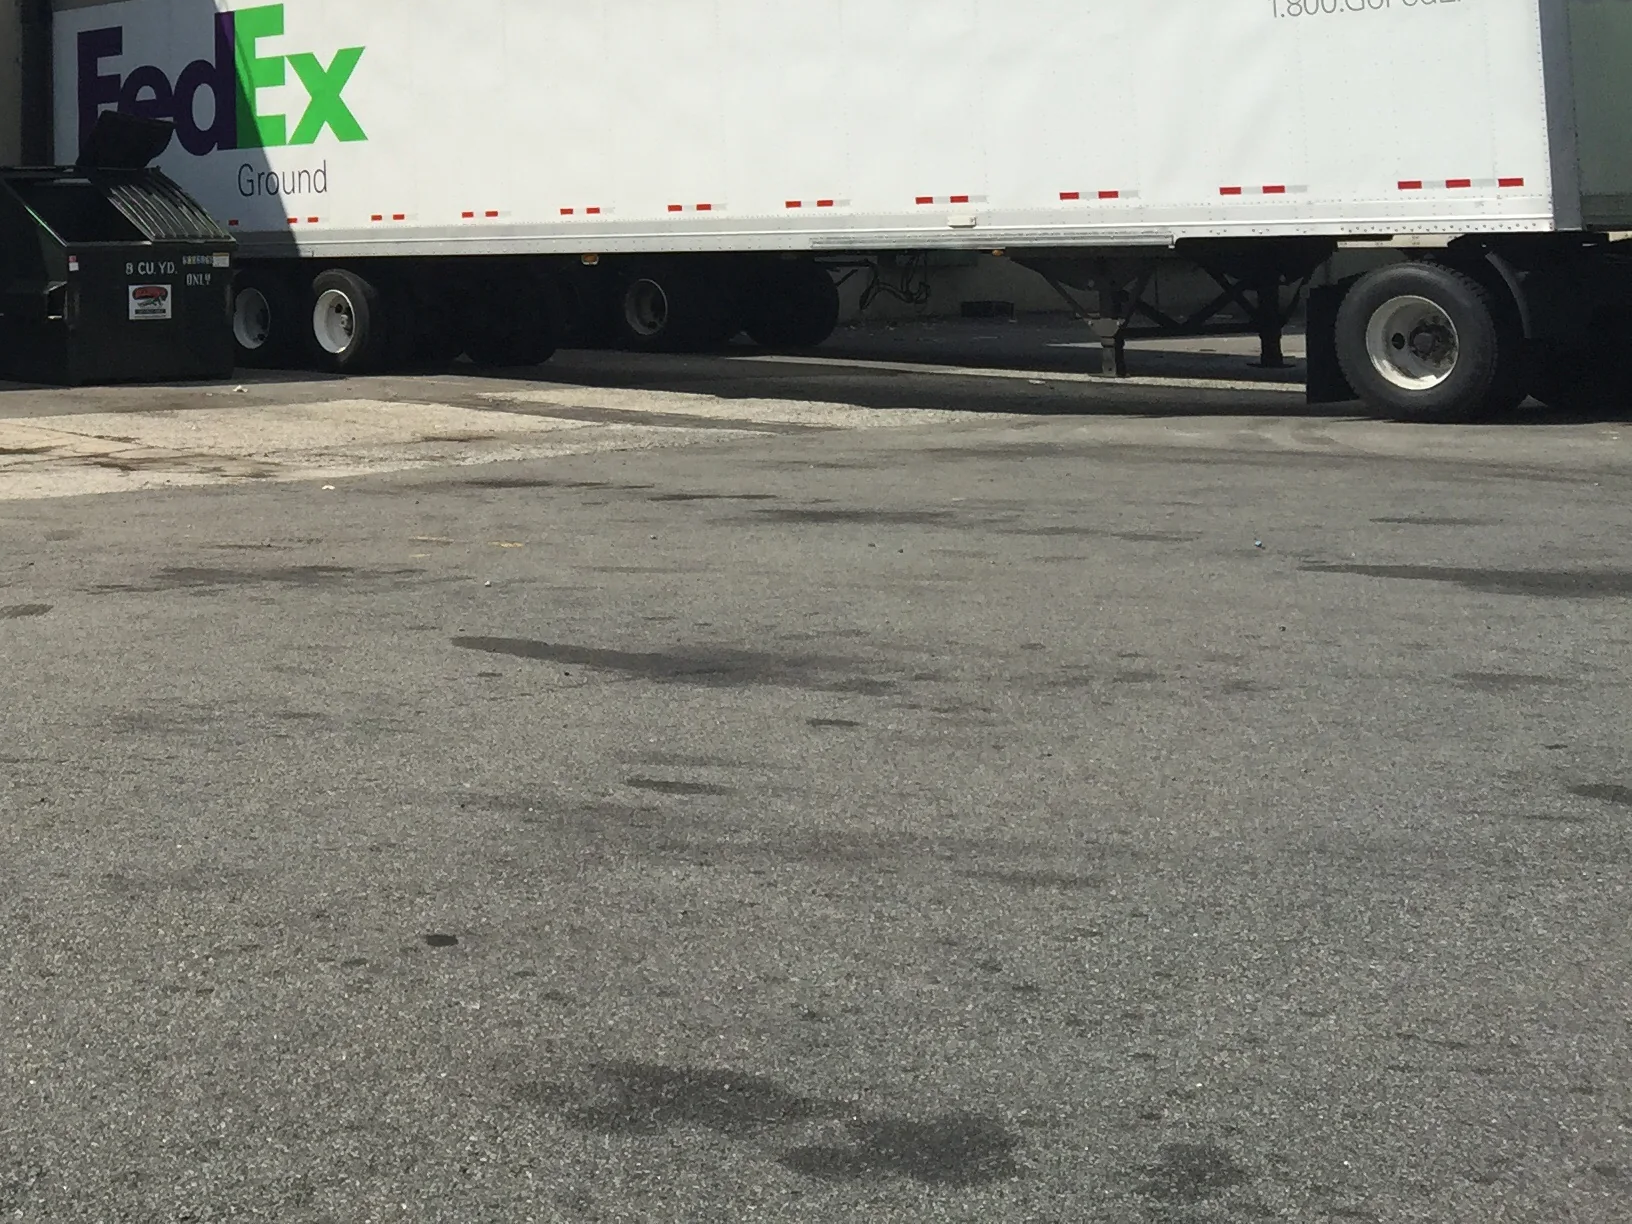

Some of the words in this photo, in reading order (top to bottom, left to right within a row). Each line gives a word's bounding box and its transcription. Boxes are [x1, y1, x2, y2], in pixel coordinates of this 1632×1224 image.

[77, 3, 368, 157] FedEx
[237, 159, 328, 197] Ground
[186, 273, 211, 286] ONLY
